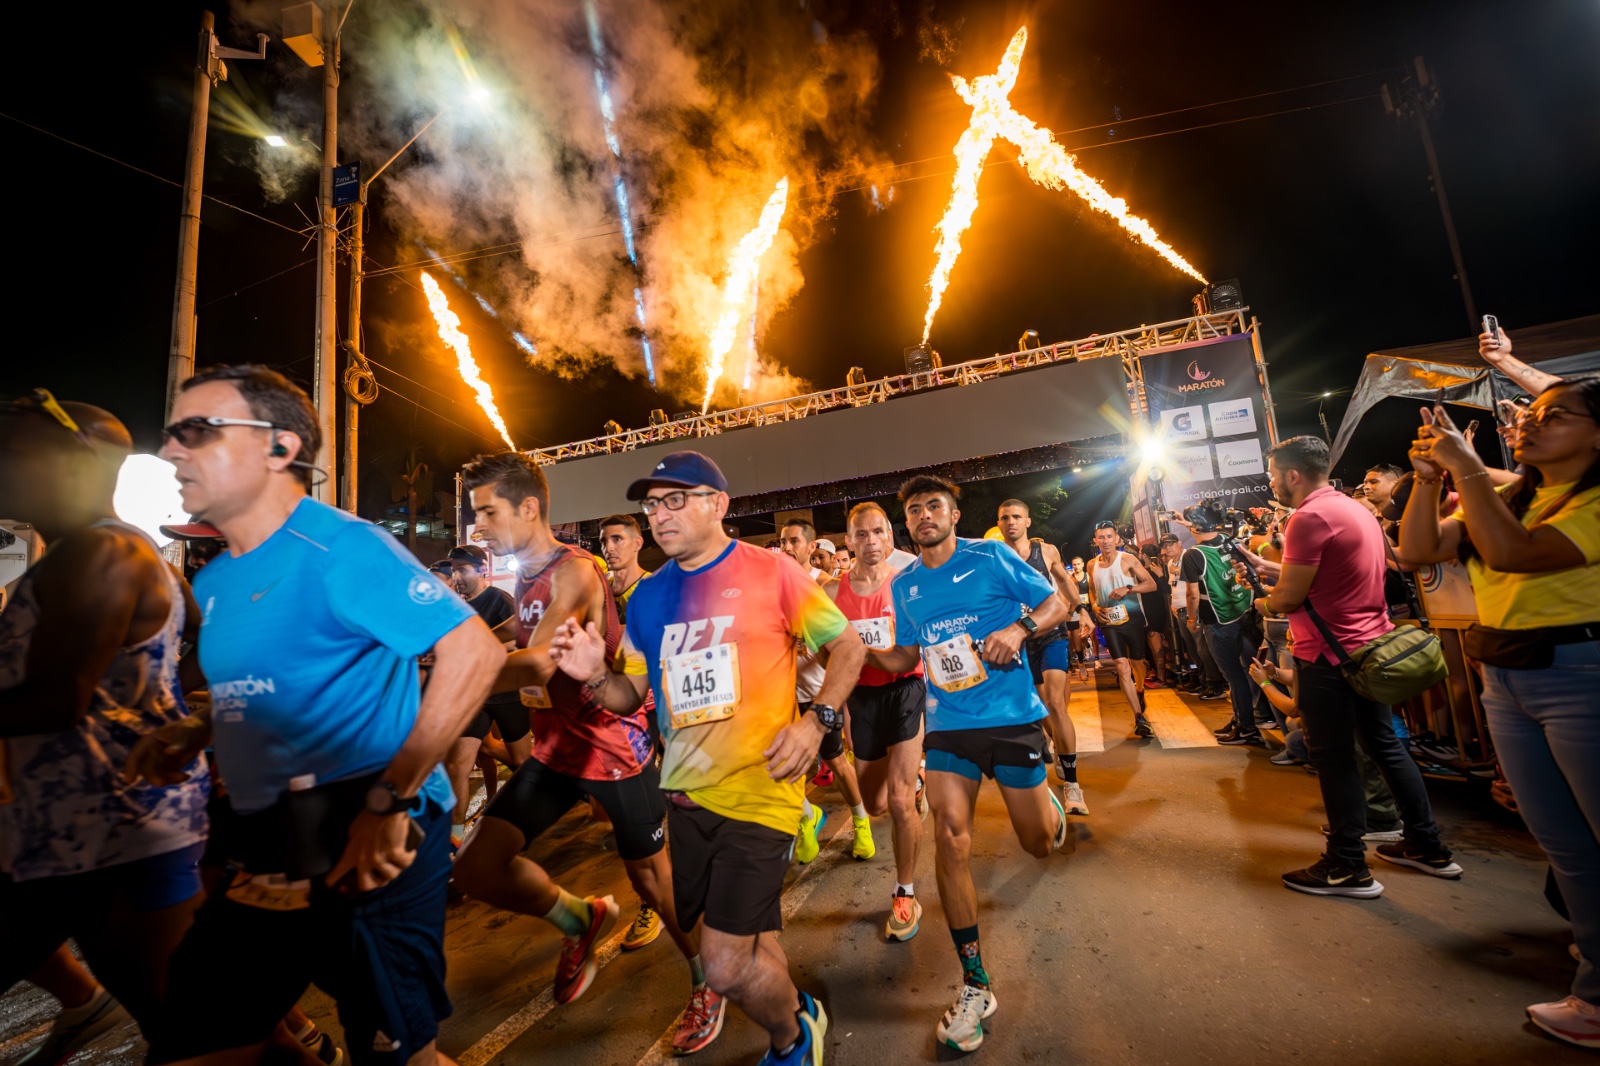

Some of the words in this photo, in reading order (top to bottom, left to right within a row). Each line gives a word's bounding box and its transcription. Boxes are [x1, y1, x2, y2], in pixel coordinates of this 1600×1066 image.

[1178, 378, 1225, 393] MARATÓN
[1228, 458, 1258, 466] Coomeva
[931, 614, 979, 632] MARATÓN
[955, 625, 967, 633] CALI
[941, 655, 963, 673] 428
[682, 669, 716, 697] 445
[712, 693, 734, 702] JESUS
[722, 706, 734, 714] 42K
